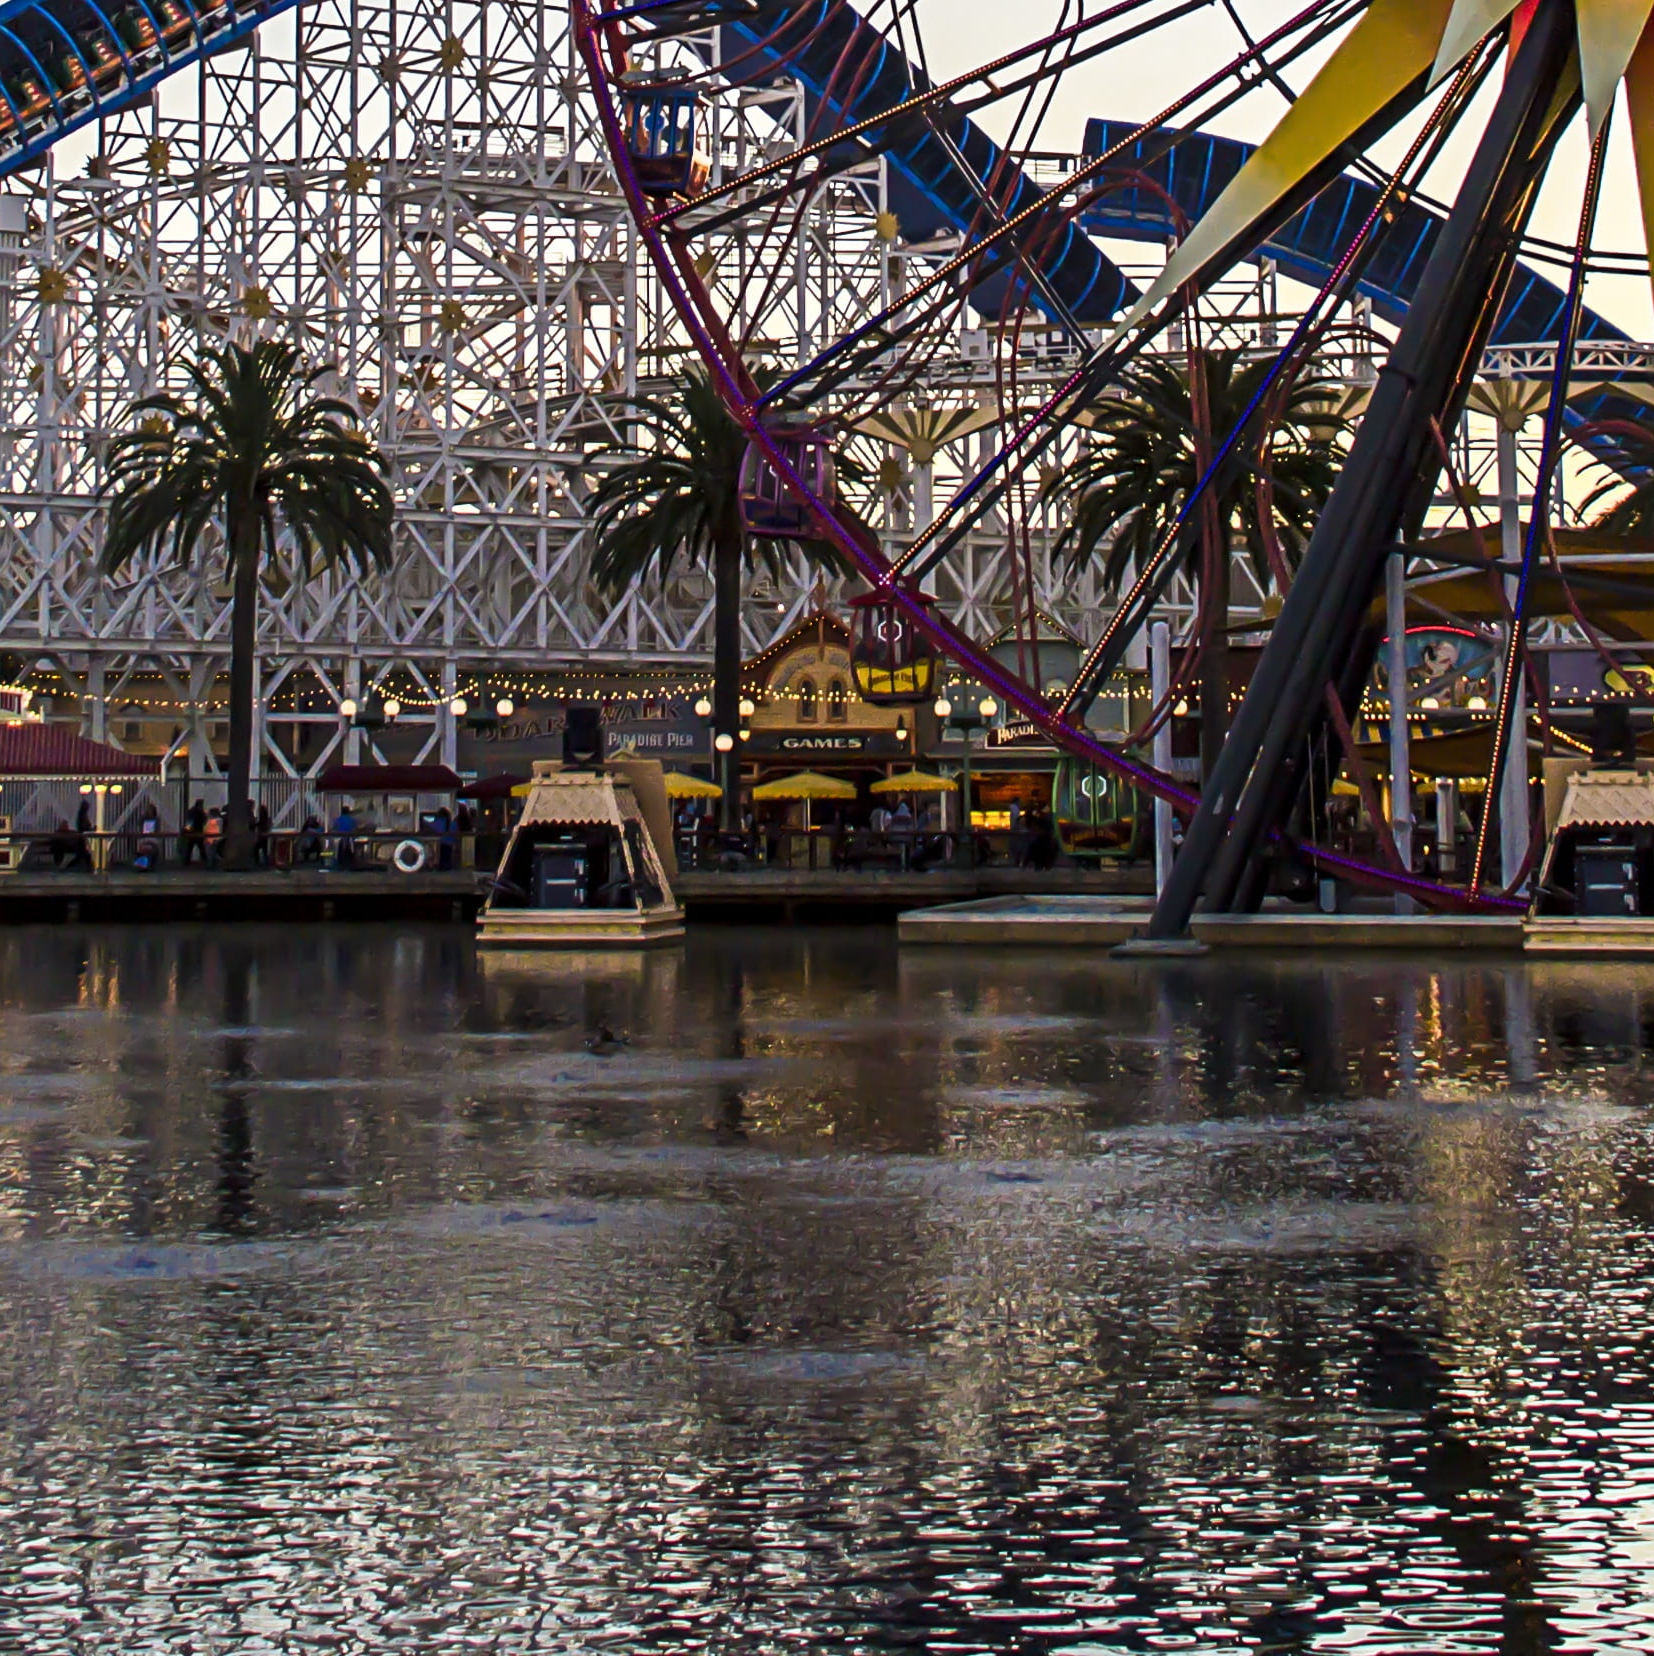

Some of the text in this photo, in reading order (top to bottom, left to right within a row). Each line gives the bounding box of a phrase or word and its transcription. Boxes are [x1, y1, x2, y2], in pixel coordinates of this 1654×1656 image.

[0, 691, 23, 716] HUT
[608, 731, 694, 748] PARADISE PIER
[782, 737, 863, 749] GAMES
[997, 723, 1040, 745] PARADI
